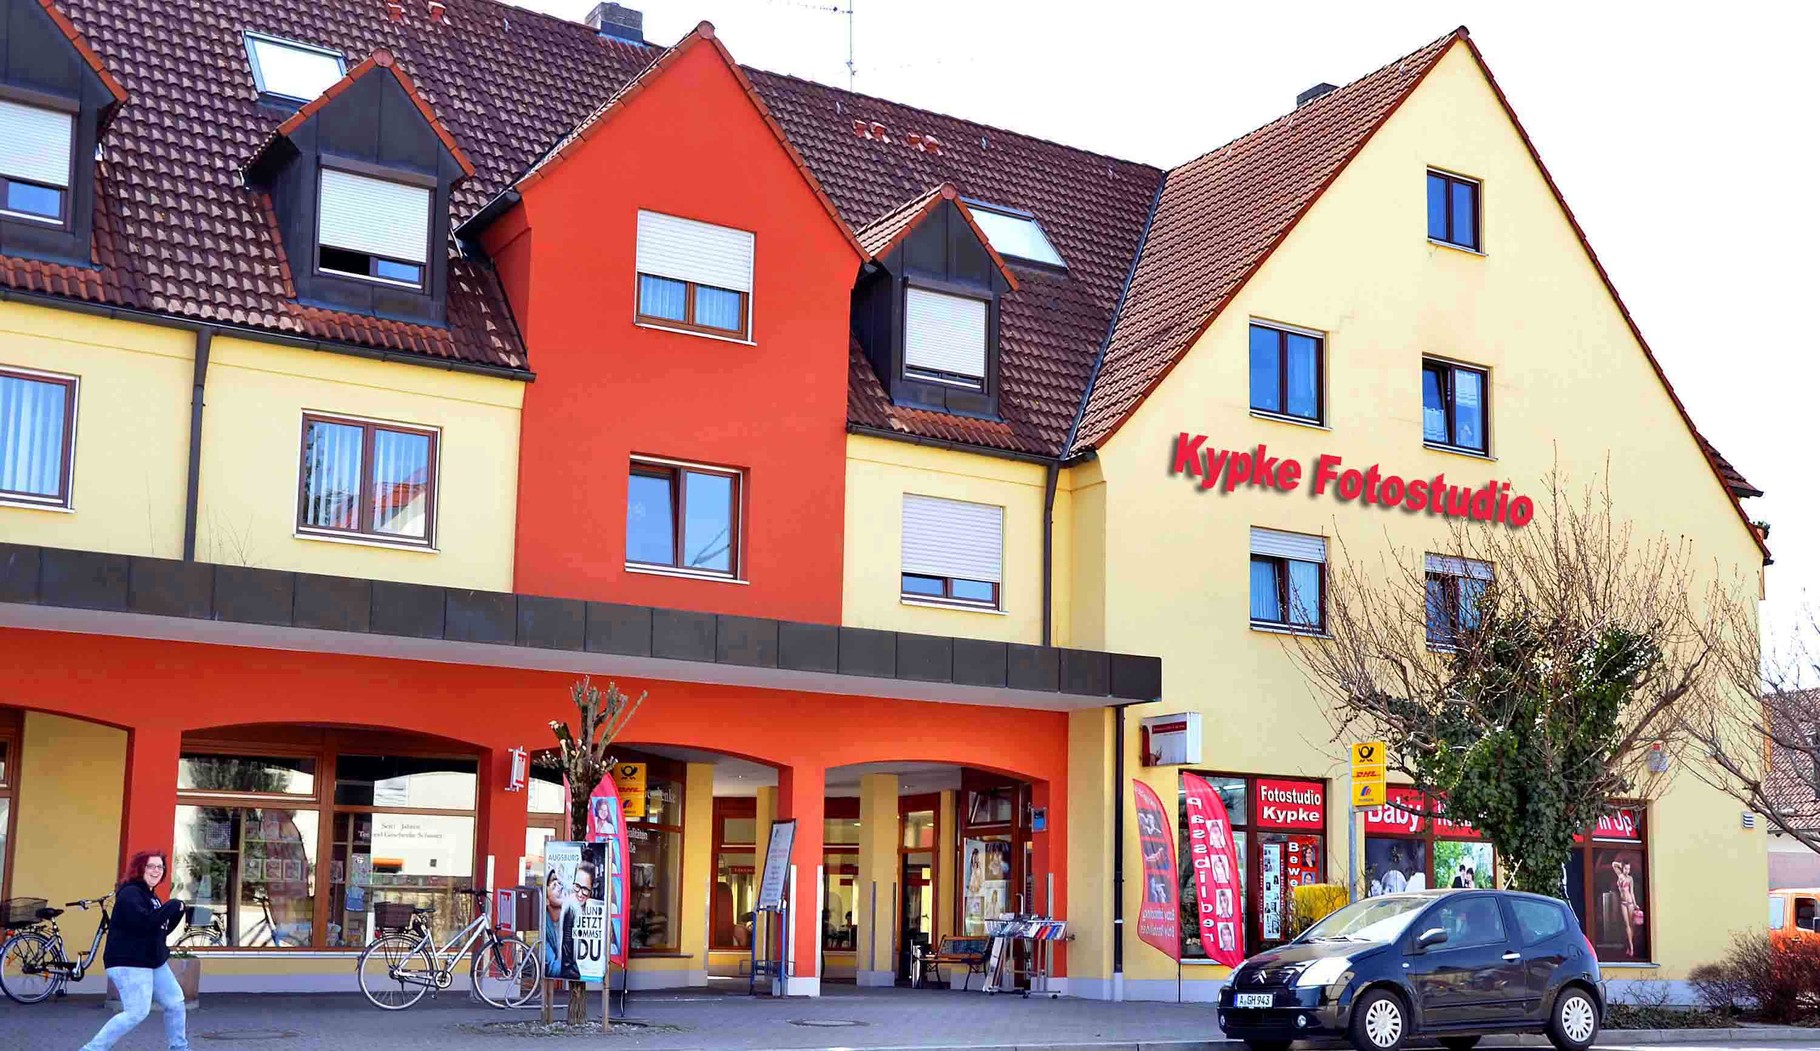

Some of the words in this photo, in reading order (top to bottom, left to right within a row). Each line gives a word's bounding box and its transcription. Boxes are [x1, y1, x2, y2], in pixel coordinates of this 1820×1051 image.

[1174, 432, 1301, 493] Kypke
[1314, 454, 1534, 527] Fotostudio
[1261, 785, 1321, 806] Fotostudio
[1263, 805, 1320, 823] Kypke
[1367, 796, 1421, 832] Baby
[547, 853, 579, 862] AUGSBURG
[576, 916, 602, 929] JETZT
[573, 929, 602, 939] KOMMST
[577, 938, 601, 962] DU
